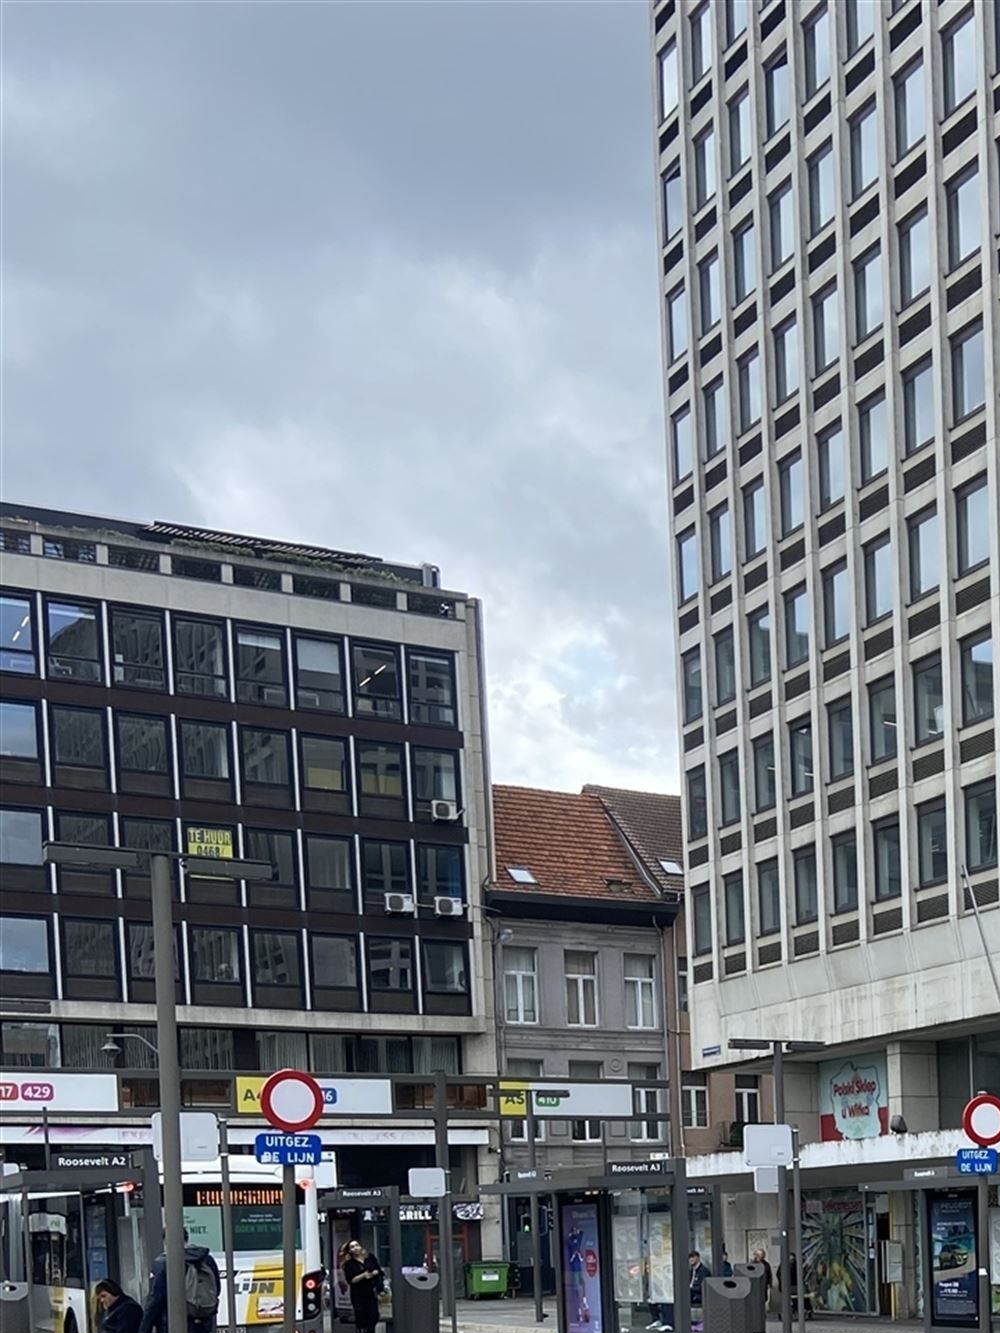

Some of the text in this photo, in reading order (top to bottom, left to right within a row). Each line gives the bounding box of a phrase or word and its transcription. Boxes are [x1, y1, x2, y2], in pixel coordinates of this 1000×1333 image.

[188, 830, 231, 846] TE HUUR
[23, 1086, 51, 1099] 429
[856, 1079, 876, 1095] Sklep
[265, 1136, 313, 1148] UITGEZ.
[58, 1156, 126, 1167] Roosevelt A2
[262, 1152, 315, 1163] DE LIJN
[611, 1163, 661, 1173] Roosevelt A3
[961, 1163, 993, 1173] DE LIJN
[399, 1209, 432, 1221] GRILL
